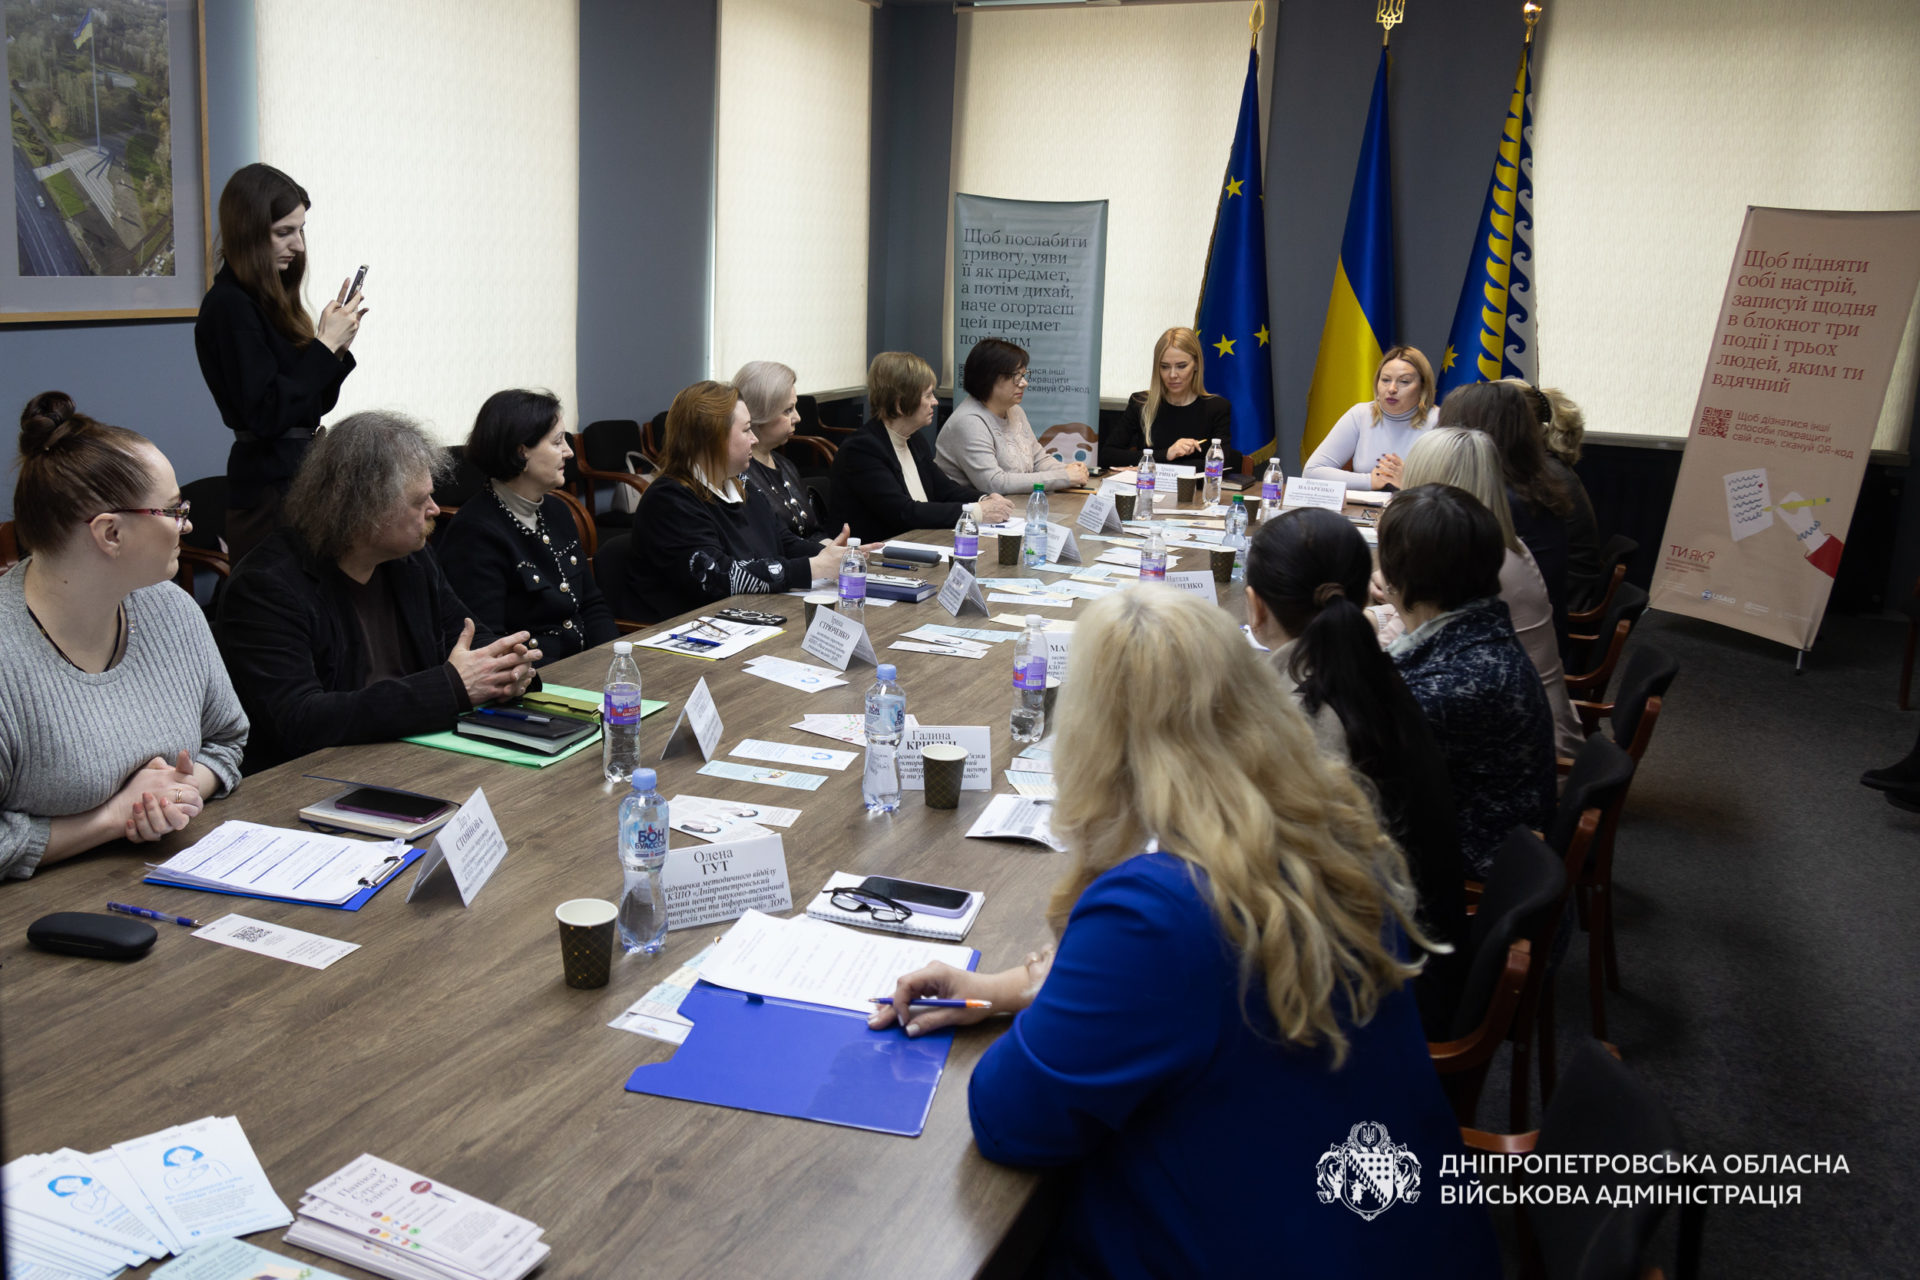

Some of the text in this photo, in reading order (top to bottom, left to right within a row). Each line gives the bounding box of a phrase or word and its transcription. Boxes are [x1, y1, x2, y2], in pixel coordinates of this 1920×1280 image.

[964, 228, 1088, 248] Щоб послабити
[963, 249, 1067, 266] тривогу, уяви
[1743, 249, 1870, 274] Щоб підняти
[962, 263, 1070, 283] її як предмет,
[961, 282, 1075, 300] а потім дихай,
[1737, 272, 1858, 297] собі настрій,
[960, 300, 1075, 317] наче огортаєш
[1731, 293, 1878, 318] записуй щодня
[960, 315, 1062, 333] цей предмет
[1727, 310, 1861, 340] в блокнот три
[1722, 332, 1839, 358] події і трьох
[1715, 352, 1865, 381] людей, яким ти
[1712, 373, 1792, 394] вдячний
[1737, 410, 1760, 423] Щоб
[1760, 415, 1809, 430] дізнатися
[1734, 422, 1833, 443] способи покращити
[1732, 432, 1753, 442] свій
[1780, 439, 1815, 453] скануй
[1817, 444, 1854, 459] QR-код
[1670, 544, 1716, 564] ТИ ЯК?
[912, 730, 951, 740] Галина
[638, 828, 665, 843] БОН
[693, 848, 734, 864] Олена
[702, 860, 729, 876] ГУТ
[702, 873, 752, 888] методичного
